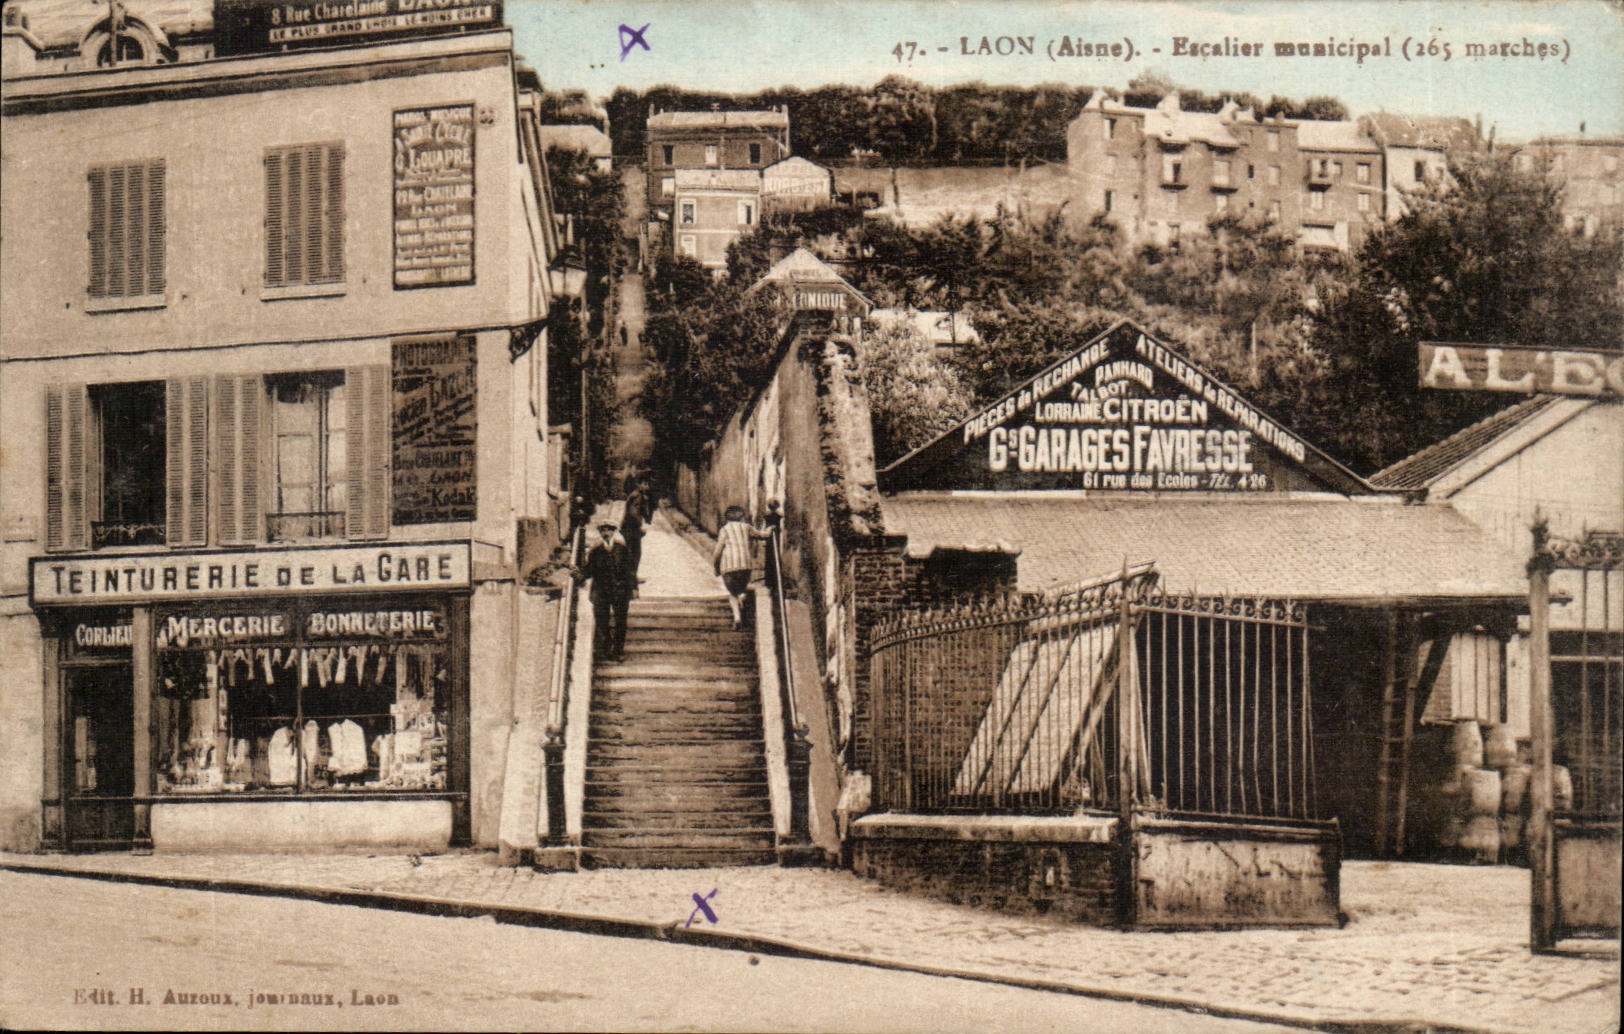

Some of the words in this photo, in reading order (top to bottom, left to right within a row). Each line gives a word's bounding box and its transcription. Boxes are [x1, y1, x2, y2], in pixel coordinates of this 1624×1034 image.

[286, 6, 311, 24] Rue
[290, 26, 320, 37] PLUS
[410, 203, 457, 219] LAON
[1033, 337, 1110, 401] RECHANGE
[1135, 333, 1204, 395] ATELIERS
[1424, 346, 1472, 388] A
[1103, 394, 1208, 424] CITROËN
[1018, 425, 1130, 472] GARAGES
[1132, 425, 1253, 472] FAVRESSE
[1083, 472, 1099, 489] 61
[1103, 474, 1128, 489] rue
[1131, 472, 1153, 489] des
[52, 564, 259, 594] TEINTURERIE
[277, 566, 315, 587] DE
[331, 563, 366, 584] LA
[377, 552, 453, 582] GARE
[158, 615, 284, 648] MERCERIE
[306, 610, 447, 639] BONNETERIE
